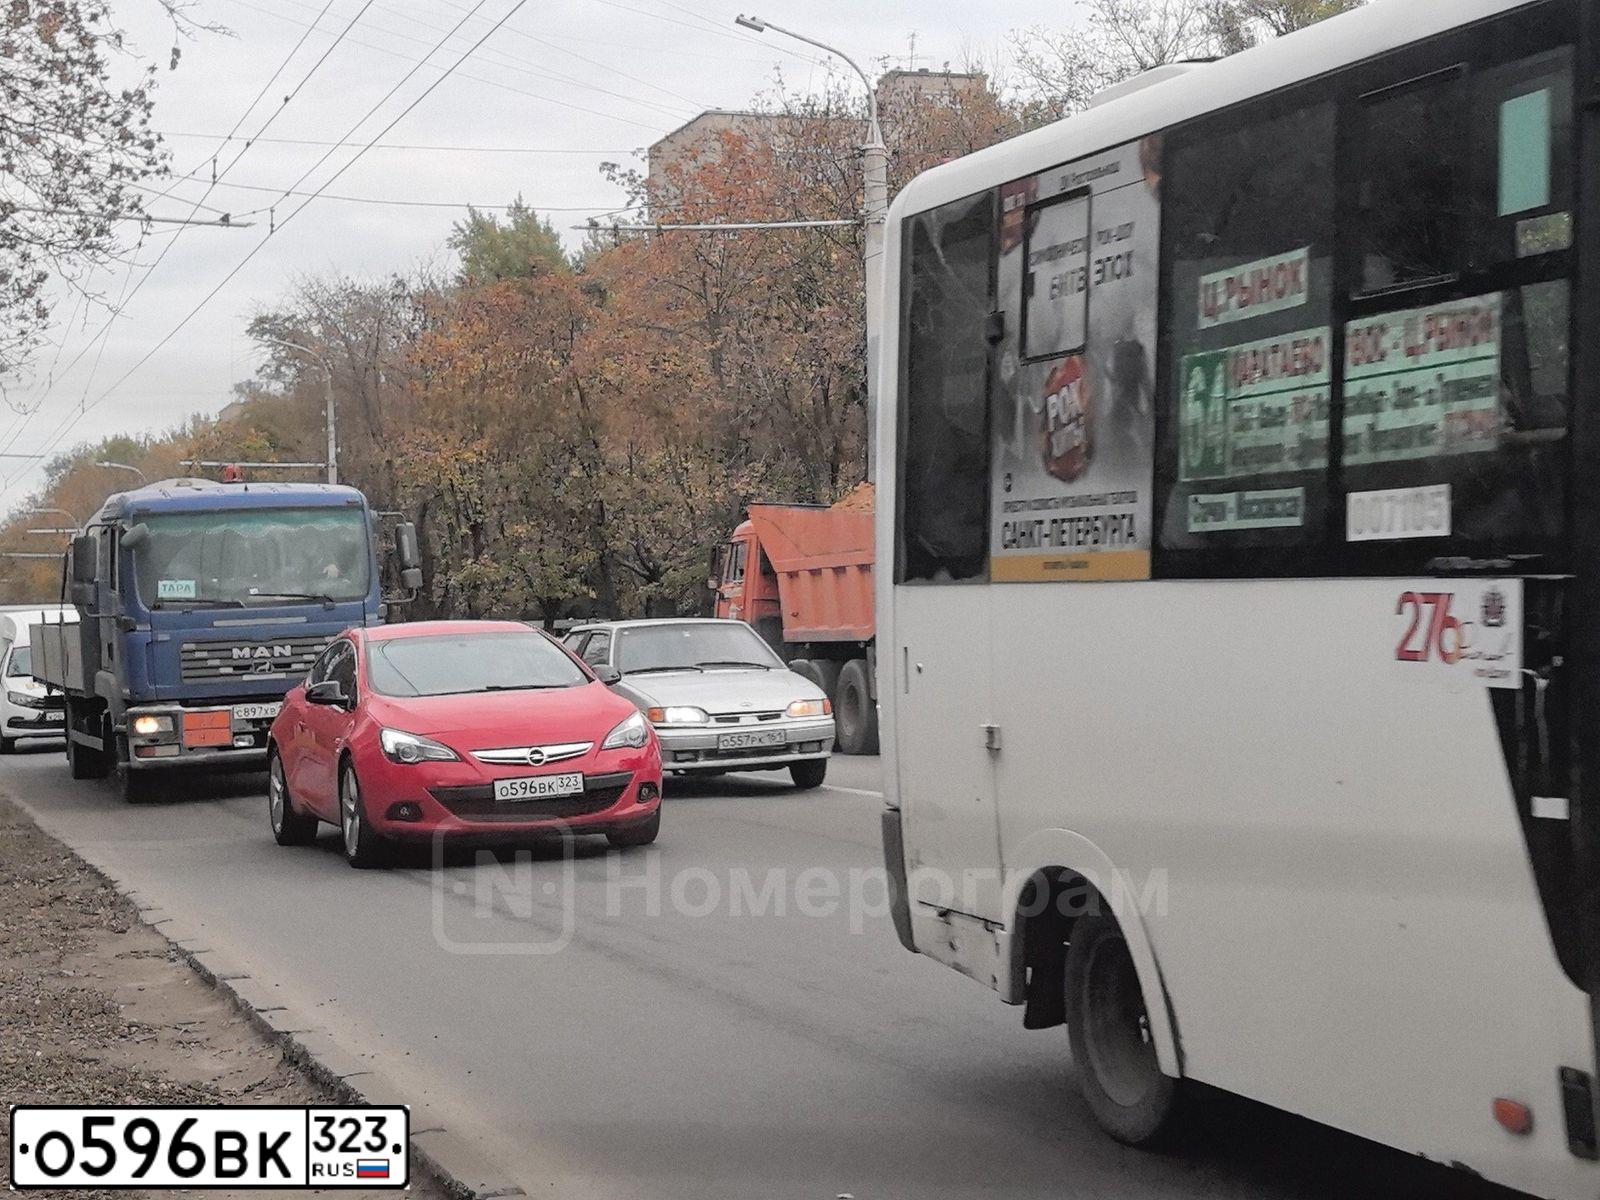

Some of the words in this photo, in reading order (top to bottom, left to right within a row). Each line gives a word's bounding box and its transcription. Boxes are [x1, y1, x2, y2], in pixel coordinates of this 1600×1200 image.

[1002, 513, 1137, 550] САНКТ-ПЕТЕРБУРГА
[161, 583, 192, 593] ТАРА
[232, 645, 292, 659] MAN
[558, 775, 579, 788] 323
